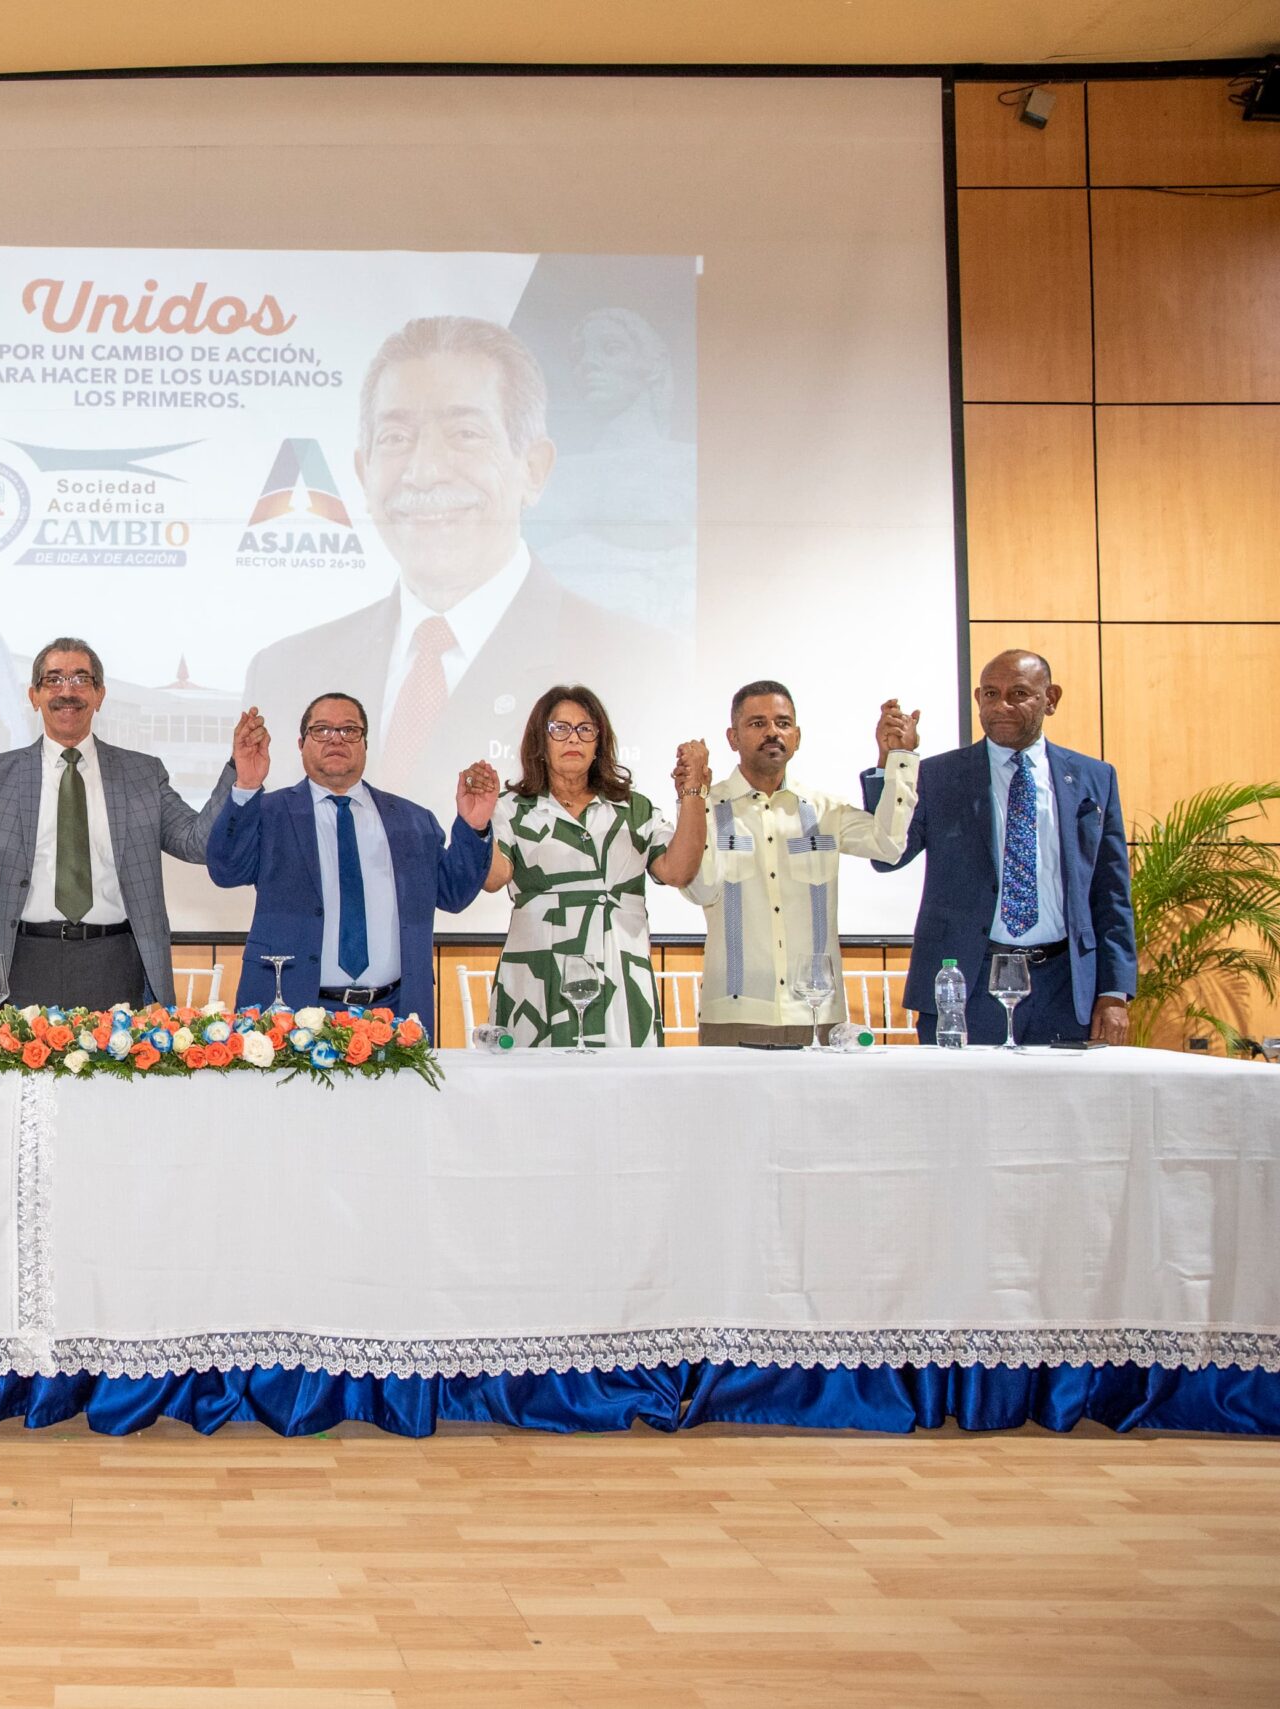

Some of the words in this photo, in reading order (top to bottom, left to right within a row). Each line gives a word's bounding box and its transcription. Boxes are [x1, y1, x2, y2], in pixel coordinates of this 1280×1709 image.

[22, 278, 297, 336] Unidos
[51, 344, 84, 361] UN
[90, 344, 183, 363] CAMBIO
[190, 345, 220, 363] DE
[225, 342, 322, 367] ACCIÓN,
[42, 367, 117, 385] HACER
[124, 368, 153, 385] DE
[160, 368, 203, 386] LOS
[209, 368, 343, 388] UASDIANOS
[74, 390, 116, 408] LOS
[122, 391, 246, 409] PRIMEROS.
[57, 479, 156, 495] Sociedad
[48, 498, 165, 514] Académica
[32, 519, 190, 547] CAMBIO
[237, 531, 364, 554] ASJANA
[35, 552, 55, 564] DE
[57, 552, 88, 564] IDEA
[91, 553, 100, 564] Y
[105, 553, 124, 564] DE
[125, 551, 177, 565] ACCIÓN
[236, 557, 287, 568] RECTOR
[291, 558, 326, 568] UASD
[489, 739, 514, 759] Dr.
